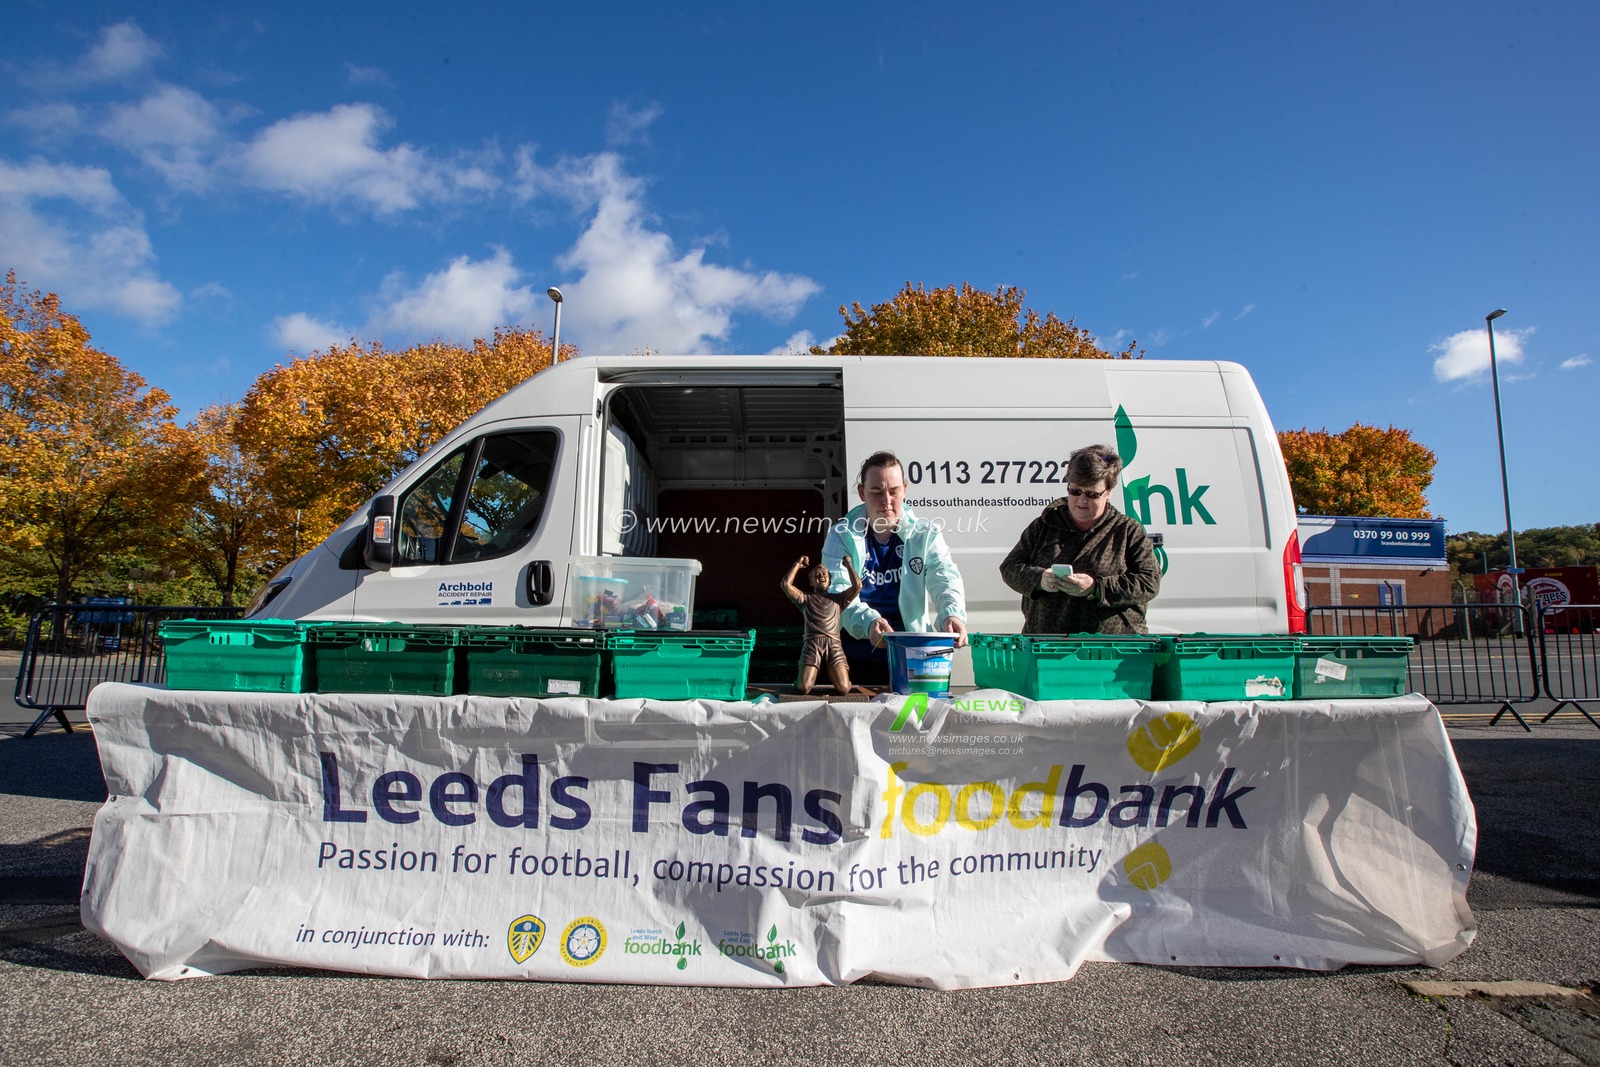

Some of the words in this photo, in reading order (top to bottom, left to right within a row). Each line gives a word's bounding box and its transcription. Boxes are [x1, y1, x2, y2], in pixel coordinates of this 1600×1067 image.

[908, 461, 971, 484] 0113
[1353, 530, 1378, 539] 0370
[1380, 531, 1393, 540] 99
[1395, 531, 1409, 540] 00
[1411, 532, 1430, 540] 999
[438, 582, 493, 591] Archbold
[320, 752, 592, 830] Leeds
[632, 761, 843, 845] Fans
[880, 762, 1257, 840] foodbank
[318, 842, 437, 872] Passion
[451, 845, 497, 873] for
[509, 847, 639, 887] football,
[653, 859, 835, 892] compassion
[849, 864, 887, 892] for
[897, 856, 939, 885] the
[950, 844, 1102, 873] community
[296, 924, 315, 943] in
[322, 926, 435, 949] conjunction
[443, 929, 490, 947] with:
[624, 938, 702, 956] foodbank
[718, 939, 797, 960] foodbank
